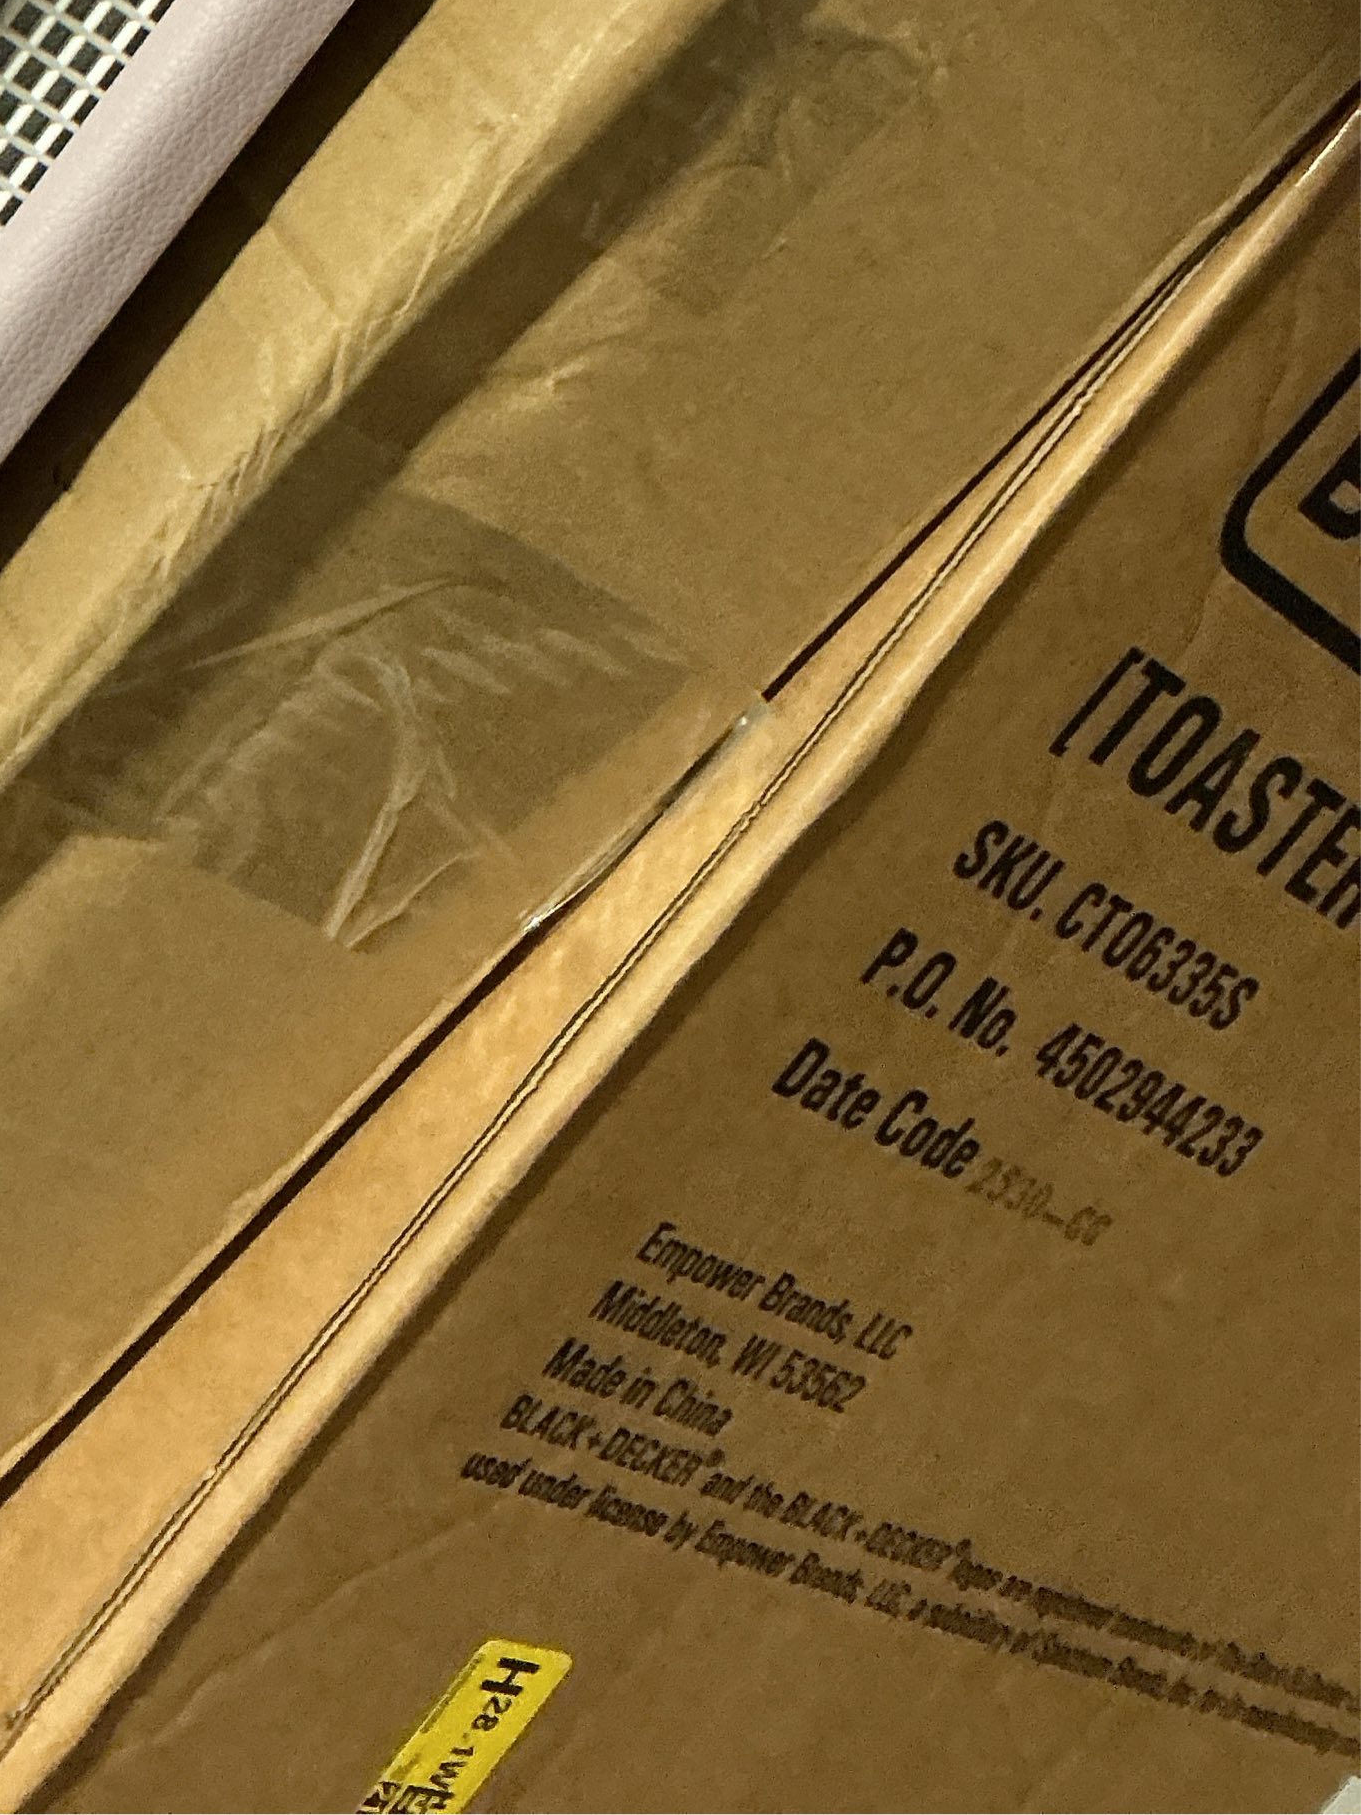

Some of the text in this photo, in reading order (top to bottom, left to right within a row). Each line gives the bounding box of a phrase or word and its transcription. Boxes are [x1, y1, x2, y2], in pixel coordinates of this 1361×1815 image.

[952, 820, 1260, 1030] SKU. CT06335S
[771, 1037, 881, 1130] Date
[874, 1089, 980, 1179] Code
[860, 927, 1264, 1177] P.O. No. 4502944233
[589, 1280, 867, 1413] Middleton, WI 53562
[636, 1222, 914, 1360] Empower Brands, LLC
[542, 1337, 733, 1436] Made in China
[460, 1452, 532, 1488] used
[517, 1469, 592, 1510] under
